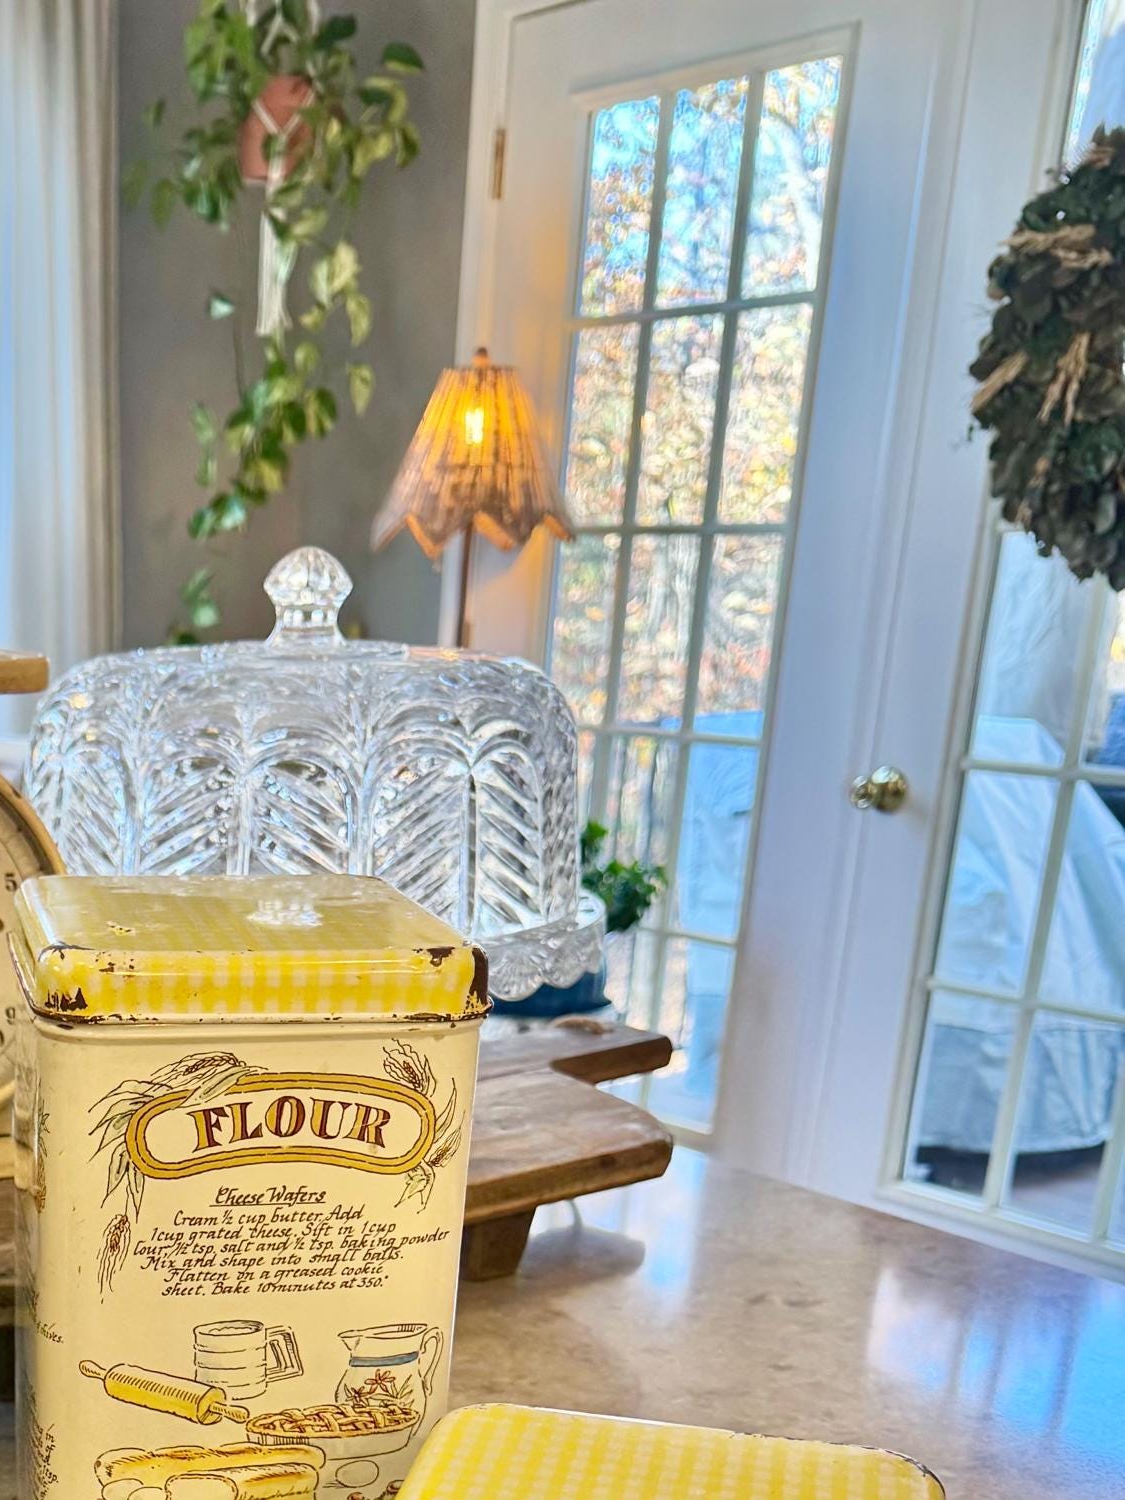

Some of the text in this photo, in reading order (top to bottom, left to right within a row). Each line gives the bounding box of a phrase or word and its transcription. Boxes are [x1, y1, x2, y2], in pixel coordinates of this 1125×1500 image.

[5, 873, 17, 891] 5
[5, 1006, 16, 1025] 9
[187, 1095, 392, 1152] FLOUR
[215, 1185, 327, 1206] Cheese Wafers
[174, 1204, 365, 1229] Cream cup butter. Add
[189, 1226, 244, 1244] grated
[302, 1222, 334, 1241] Sift
[338, 1224, 354, 1236] in
[220, 1239, 254, 1253] salt
[256, 1237, 290, 1252] and
[340, 1234, 394, 1250] baking
[398, 1227, 450, 1248] powder
[141, 1256, 175, 1271] Mix
[182, 1253, 216, 1268] and
[220, 1253, 266, 1270] shape
[271, 1253, 301, 1266] into
[309, 1247, 362, 1263] small
[164, 1262, 383, 1284] Flatten on a greased cookie
[211, 1281, 250, 1295] Bake
